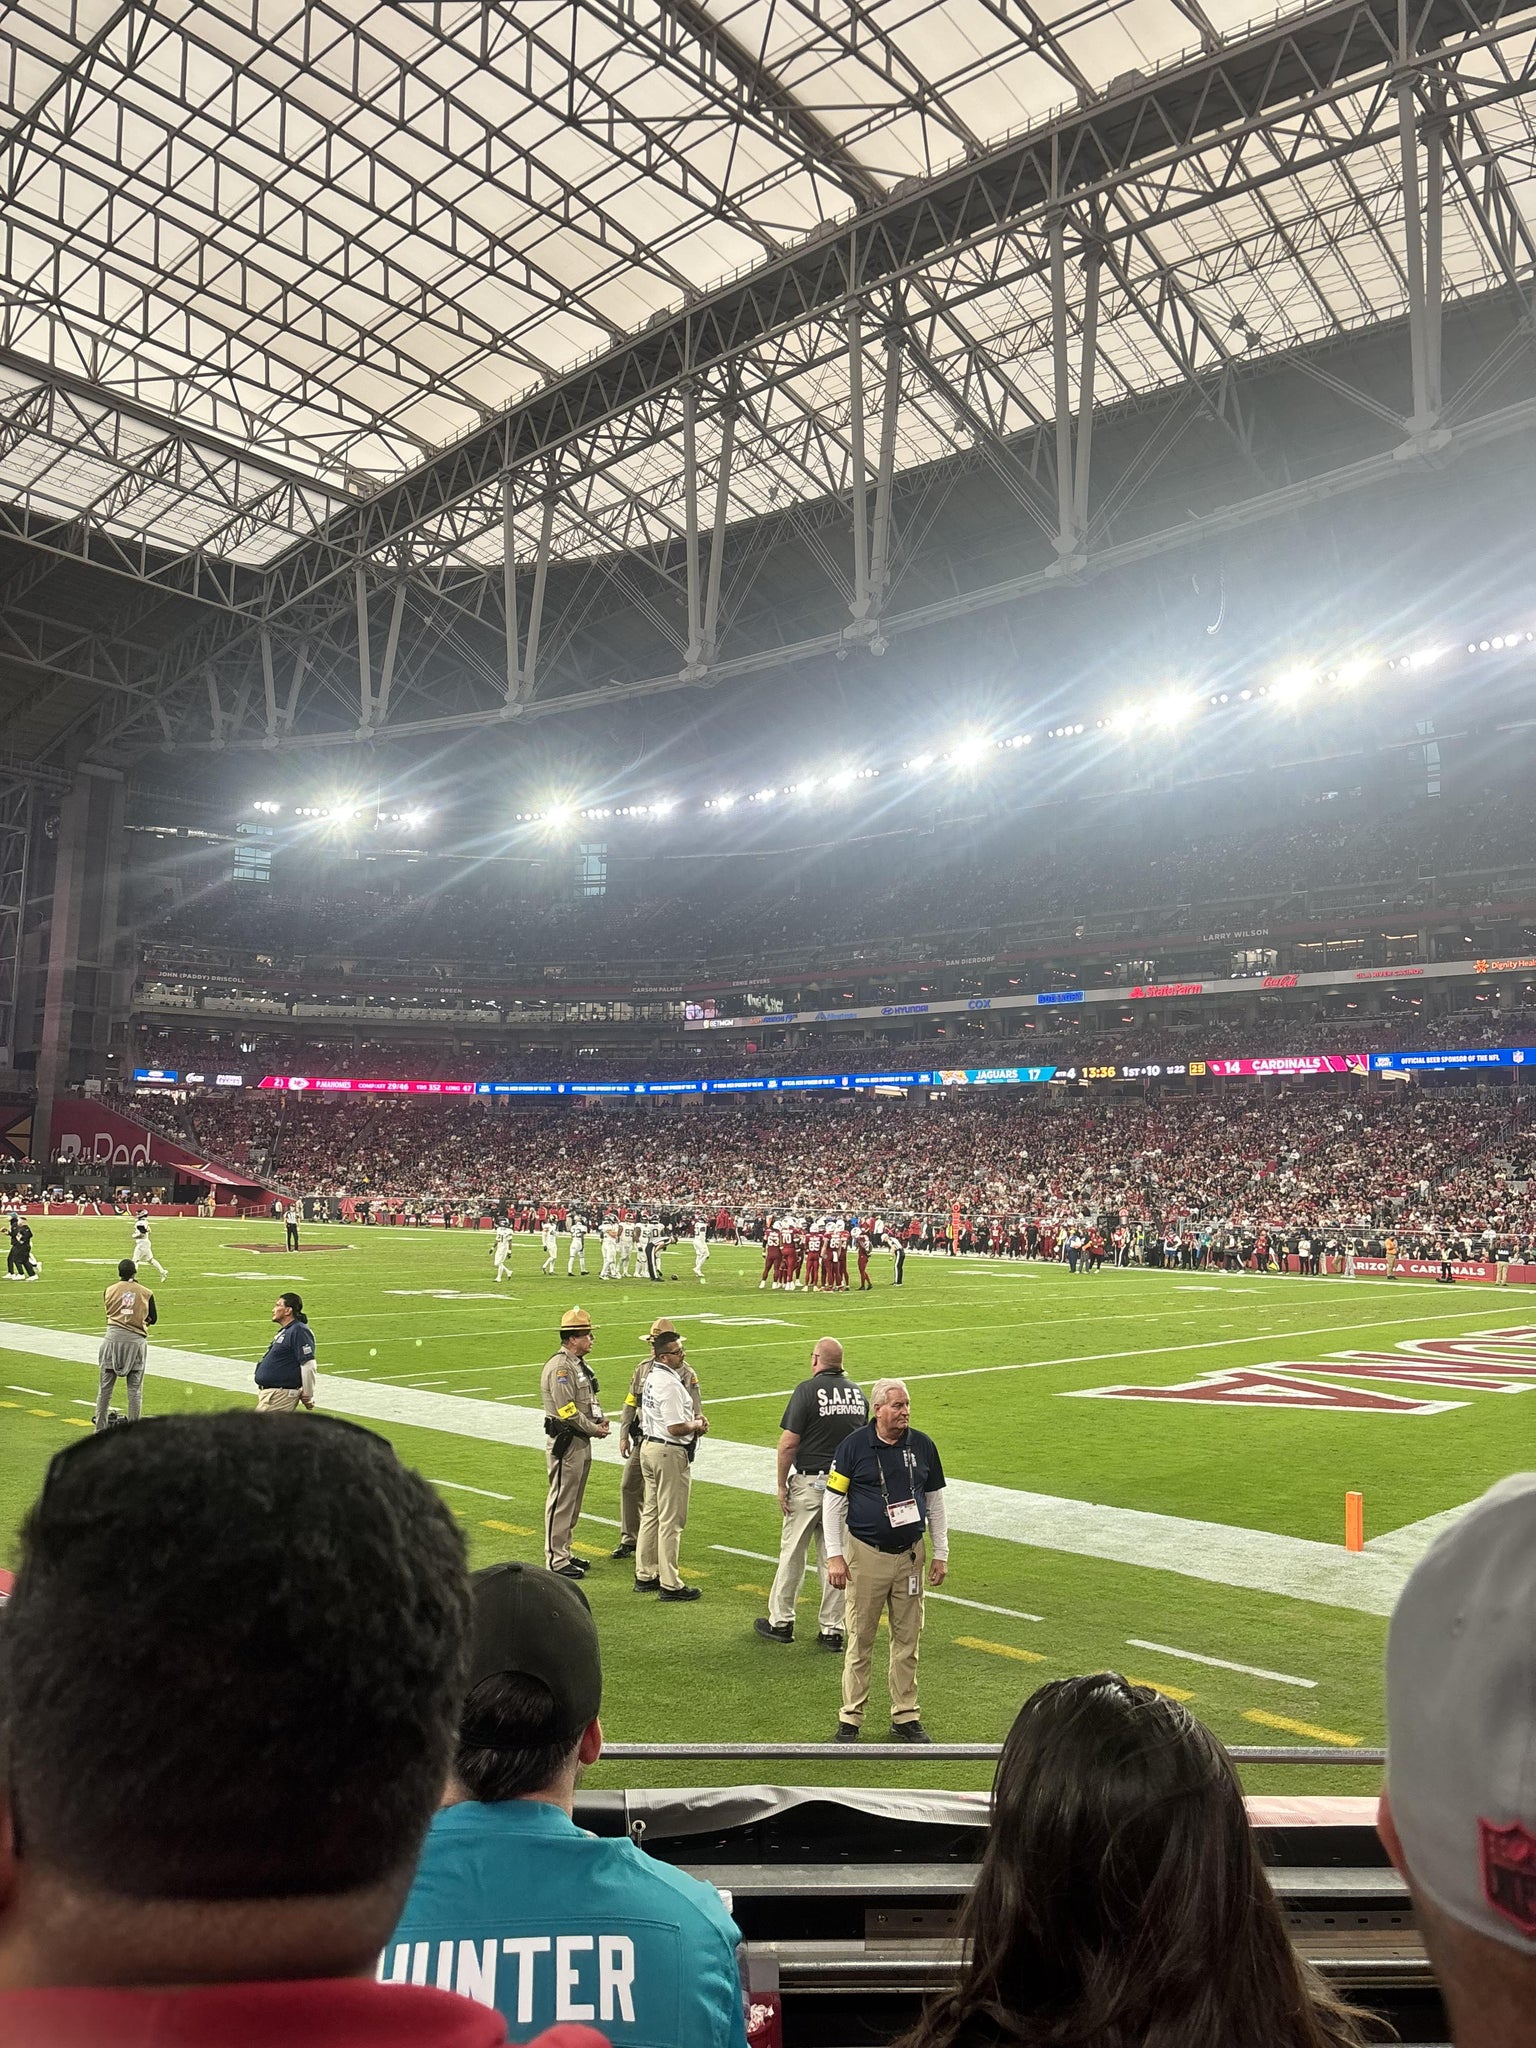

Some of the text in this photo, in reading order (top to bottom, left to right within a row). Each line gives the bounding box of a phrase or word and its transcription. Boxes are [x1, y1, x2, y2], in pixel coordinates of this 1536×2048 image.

[1203, 928, 1269, 942] LARRY WILSON
[946, 955, 996, 966] DAN DIERDORF
[1491, 959, 1536, 970] Dignity Heal
[158, 971, 246, 984] JOHN (PADDY) DRISCOLL
[1372, 970, 1393, 978] RIVER
[894, 1005, 929, 1014] HYUNDAI
[968, 1000, 991, 1009] COX
[1224, 1056, 1321, 1074] 14 CARDINALS
[1401, 1056, 1426, 1065] OFFICIAL
[1426, 1056, 1441, 1064] BEER
[1441, 1055, 1467, 1063] SPONSOR
[1476, 1054, 1487, 1062] THE
[1488, 1054, 1500, 1062] NFL
[1067, 1068, 1076, 1079] 4
[1082, 1066, 1116, 1078] 13:36
[1122, 1066, 1140, 1077] 1ST
[1147, 1065, 1161, 1076] 10
[1191, 1064, 1203, 1073] 25
[976, 1069, 1041, 1080] JAGUARS 17
[387, 1082, 409, 1091] 29/46
[767, 1236, 779, 1247] 63
[782, 1233, 792, 1244] 70
[808, 1240, 820, 1251] 89
[1352, 1261, 1486, 1276] ARIZOA CARDNALS
[819, 1404, 865, 1417] SUPERVISOR
